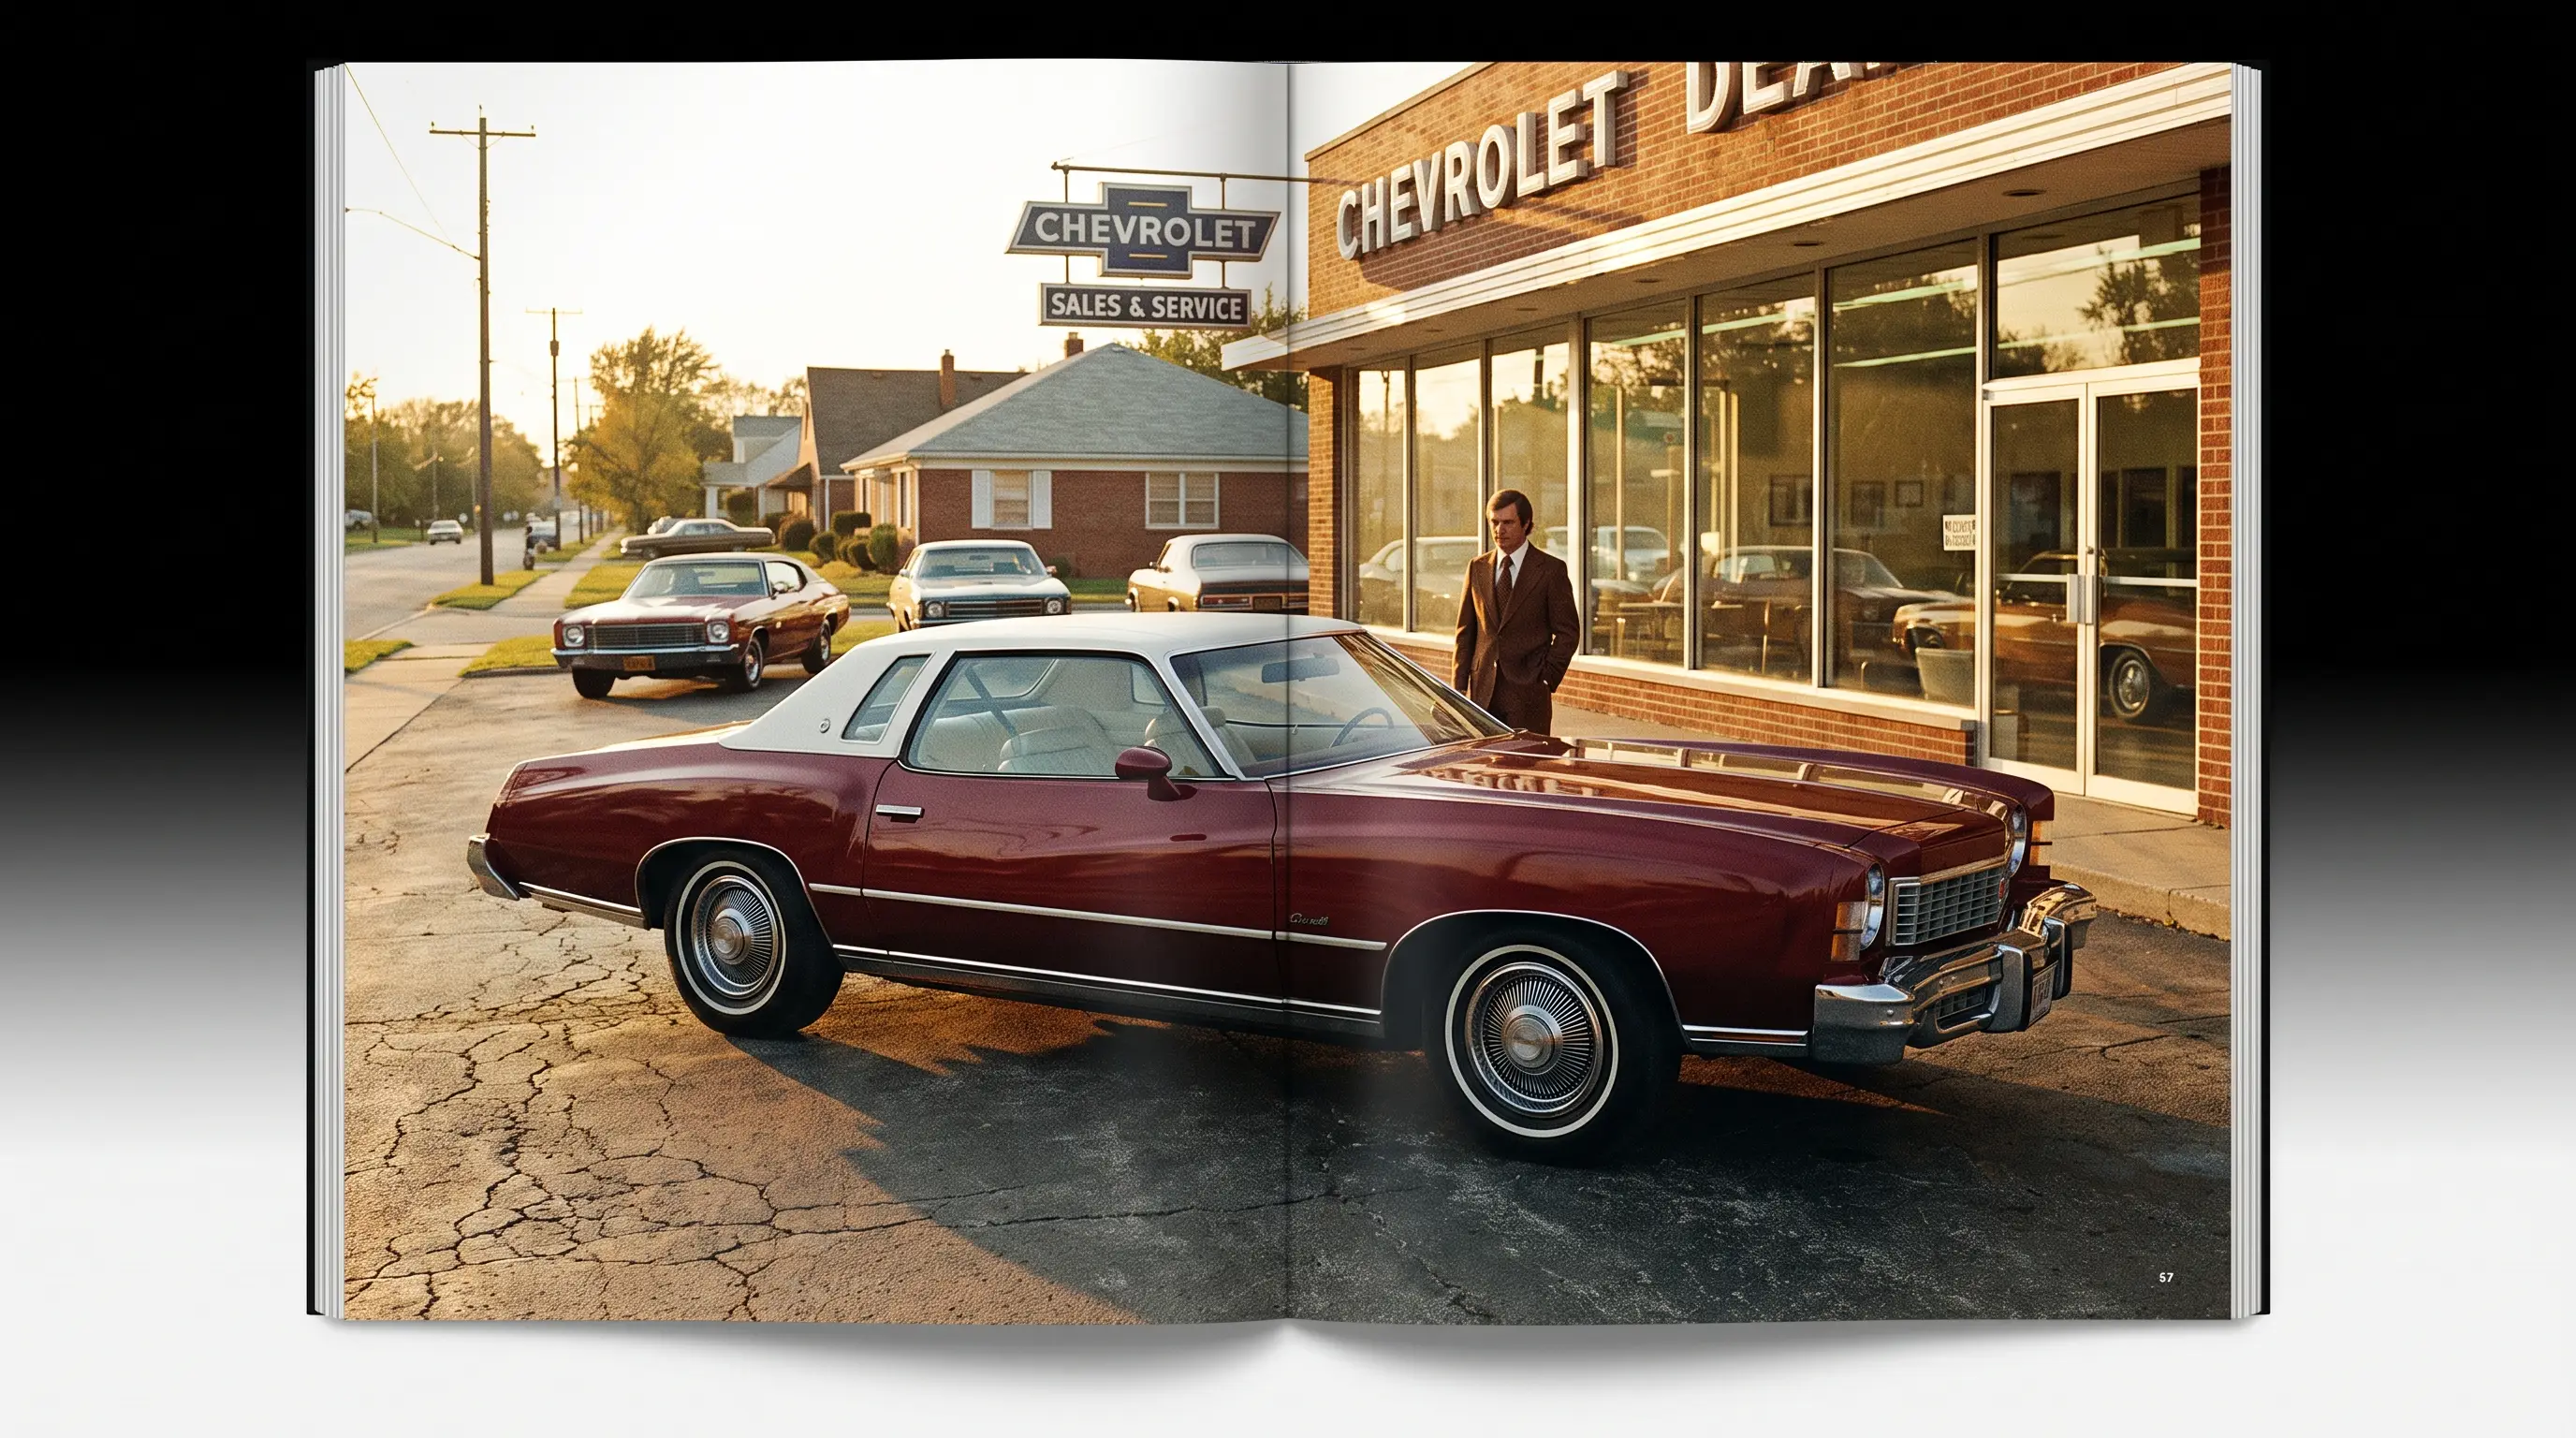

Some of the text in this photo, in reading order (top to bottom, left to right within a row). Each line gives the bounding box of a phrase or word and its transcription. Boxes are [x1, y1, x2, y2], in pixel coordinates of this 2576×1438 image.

[1337, 70, 1628, 260] CHEVROLET
[1034, 212, 1256, 248] CHEVROLET
[1051, 293, 1242, 320] SALES & SERVICE
[2159, 1272, 2174, 1283] 57
